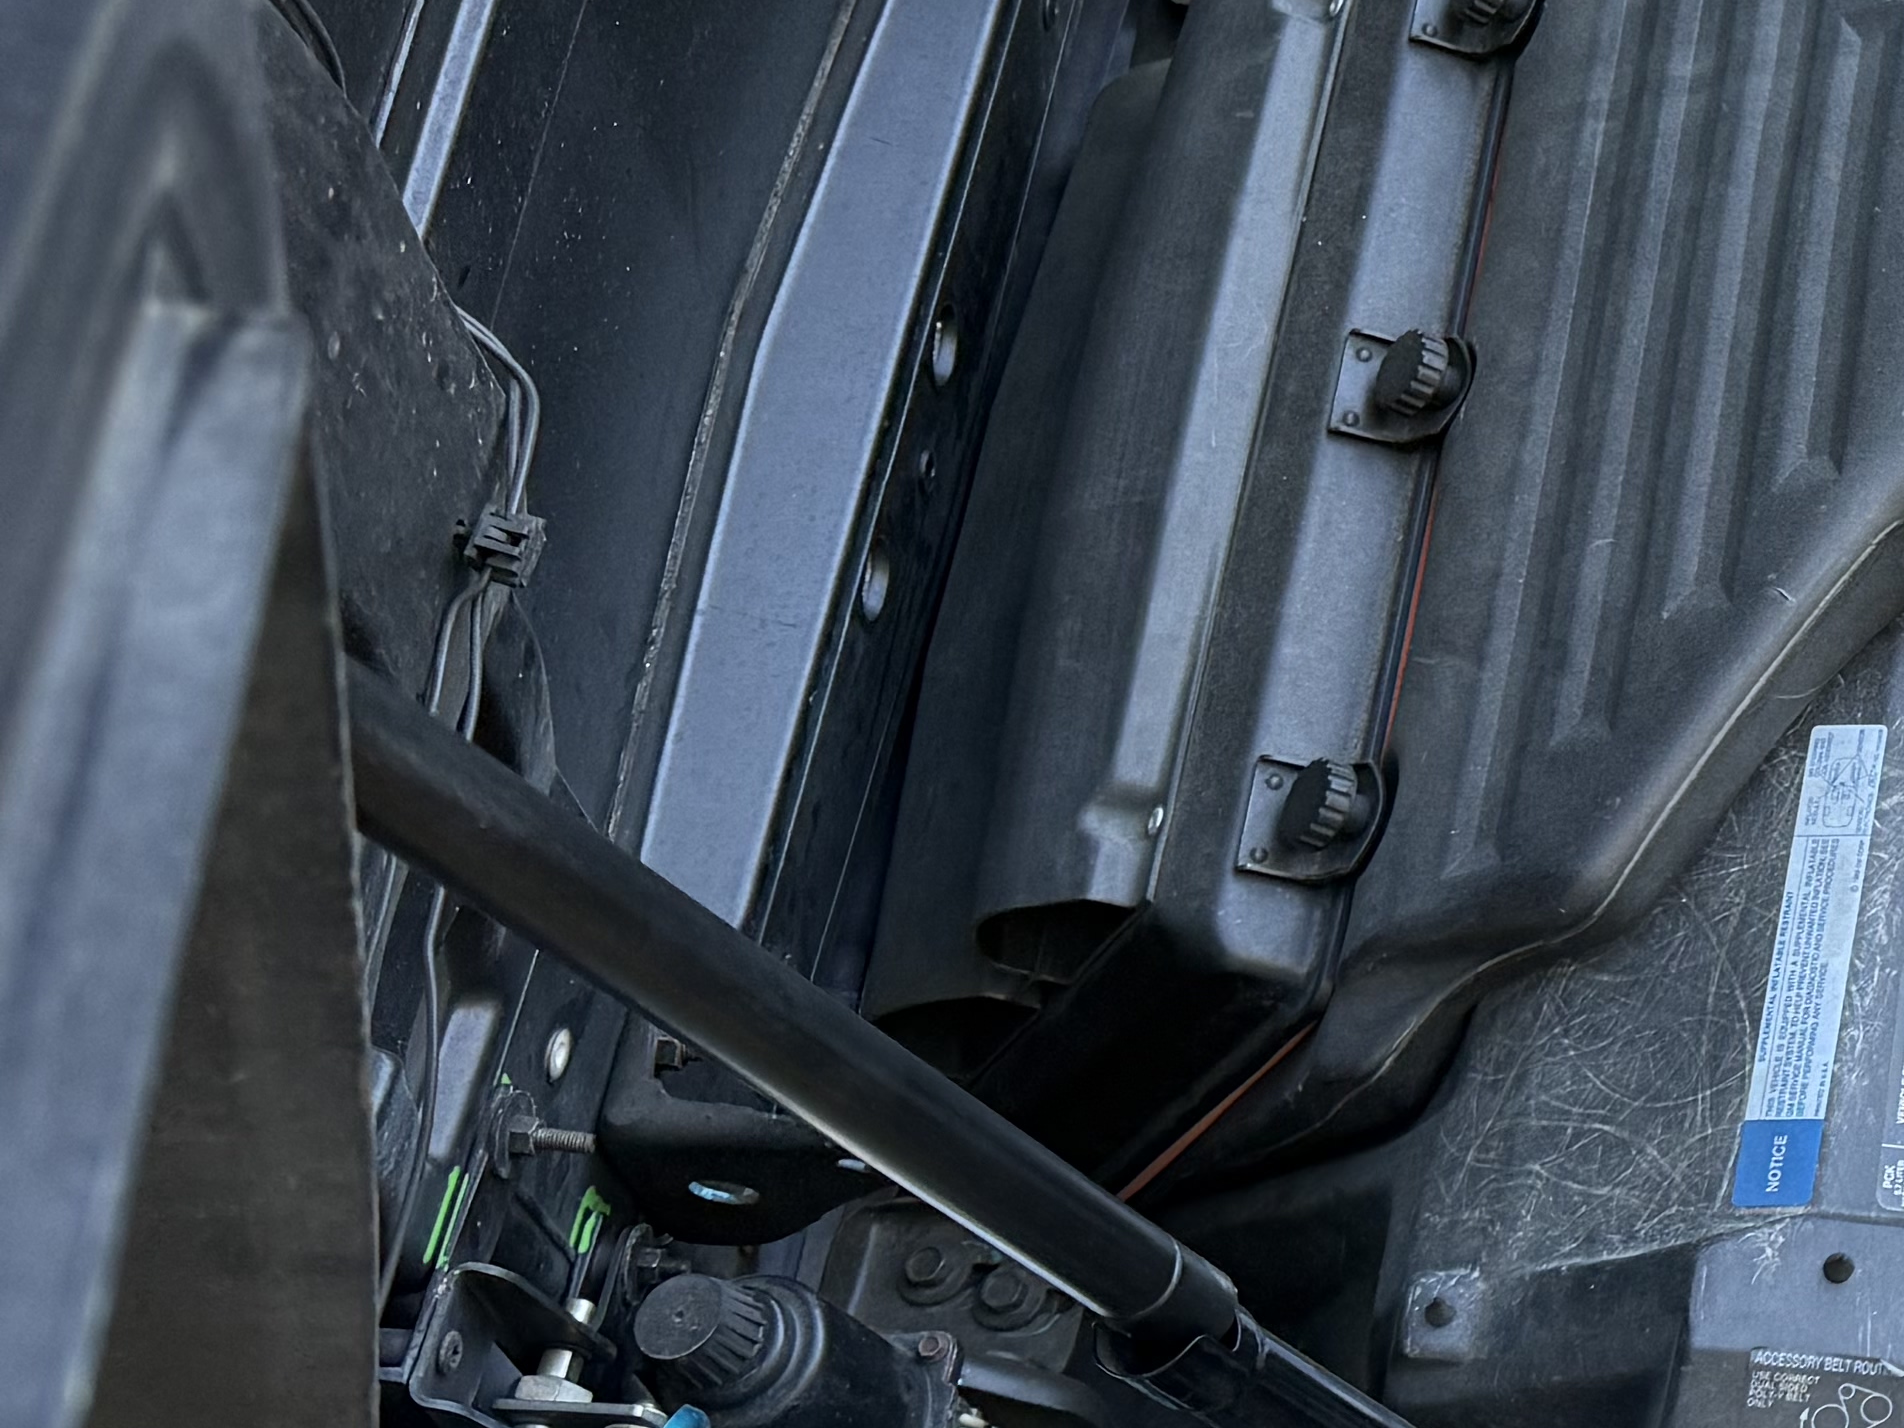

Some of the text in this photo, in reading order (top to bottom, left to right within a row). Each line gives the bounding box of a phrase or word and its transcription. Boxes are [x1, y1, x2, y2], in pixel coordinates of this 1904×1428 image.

[1804, 838, 1820, 887] INFLATABLE
[1822, 838, 1839, 894] PROCEDURES
[1816, 896, 1830, 931] SERVICE
[1813, 933, 1824, 951] AND
[1758, 891, 1794, 1062] SUPPLEMENTAL INFLATABLE RESTRAINT
[1786, 970, 1798, 992] WITH
[1790, 1016, 1800, 1027] TO
[1801, 1006, 1812, 1024] FOR
[1811, 1001, 1822, 1019] ANY
[1776, 1043, 1786, 1052] IS
[1794, 1026, 1808, 1061] MANUAL
[1769, 1055, 1784, 1093] VEHICLE
[1788, 1063, 1802, 1100] SERVICE
[1765, 1096, 1777, 1116] THIS
[1765, 1134, 1788, 1192] NOTICE
[1882, 1163, 1896, 1188] PCK
[1754, 1349, 1822, 1371] ACCESSORY
[1823, 1356, 1850, 1373] BELT
[1751, 1370, 1819, 1385] USE CORRECT
[1746, 1396, 1774, 1409] ONLY
